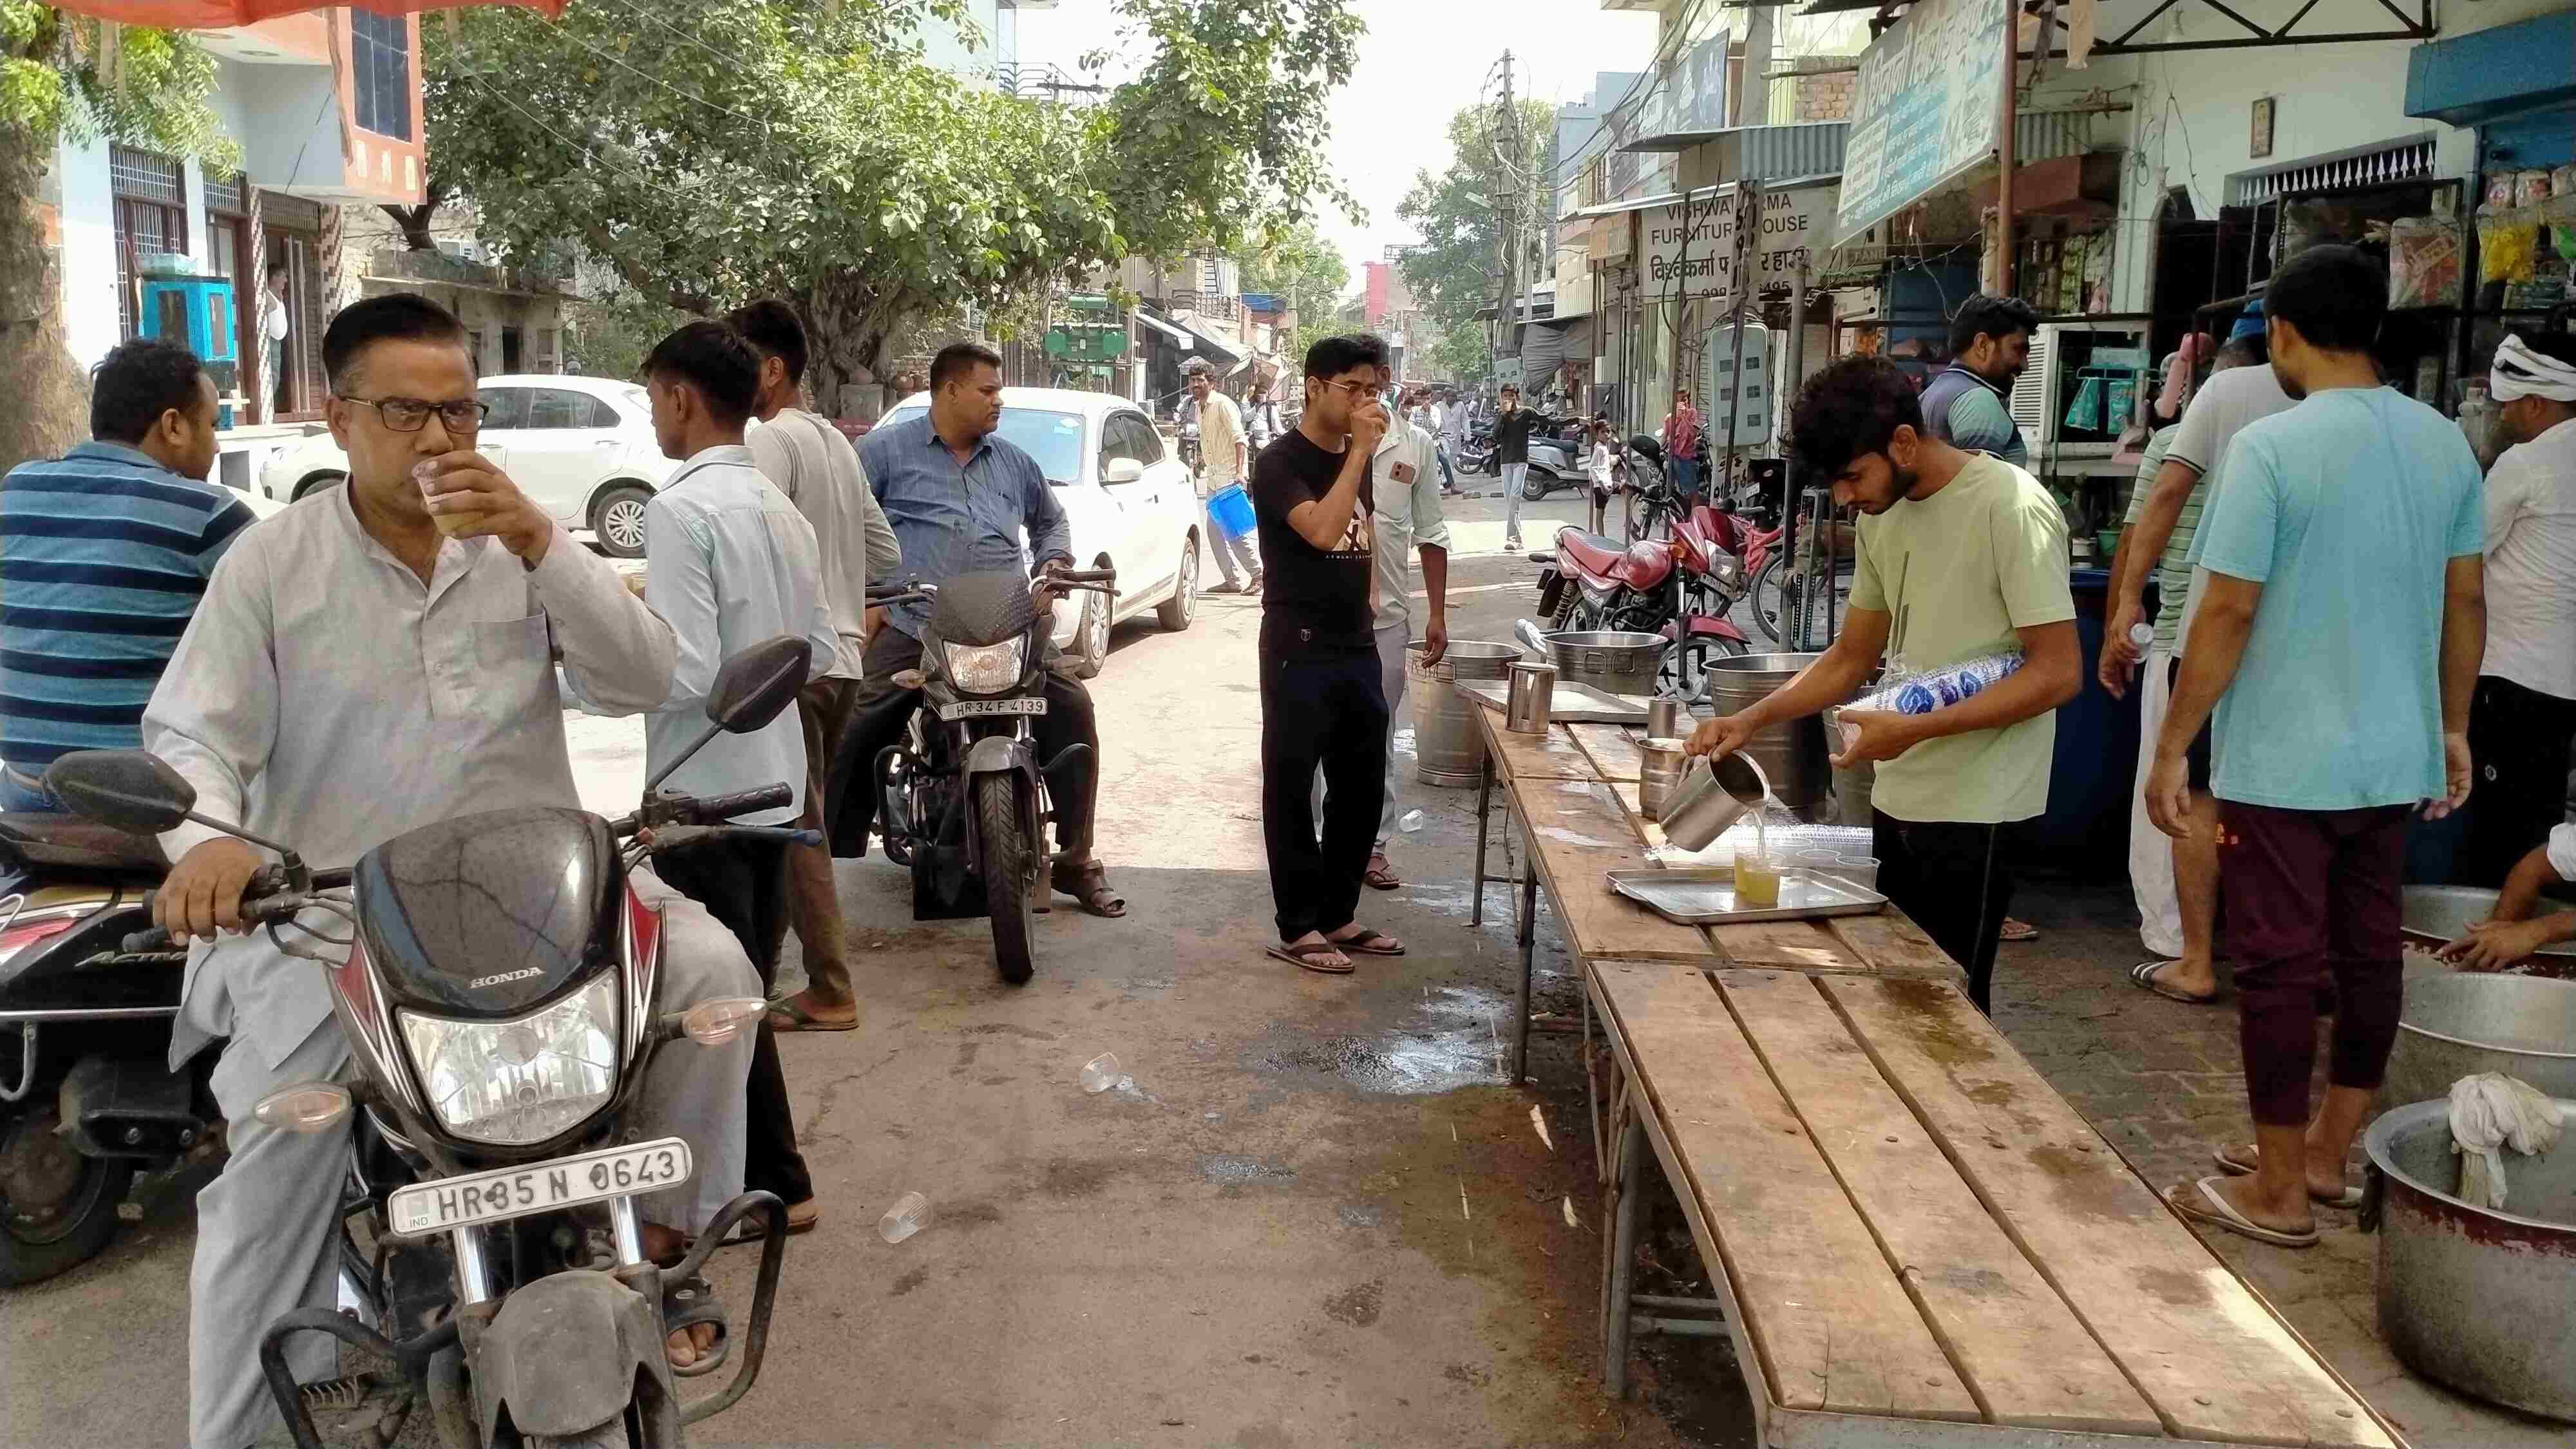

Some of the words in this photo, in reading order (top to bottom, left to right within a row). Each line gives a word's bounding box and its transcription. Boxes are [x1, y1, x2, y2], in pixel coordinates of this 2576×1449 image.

[1667, 193, 1792, 220] VIHWAMA
[1651, 223, 1732, 245] FURNITUR
[1763, 215, 1808, 234] OUSE
[469, 967, 547, 989] HONDA
[549, 1170, 569, 1200] N
[409, 1217, 428, 1228] IND
